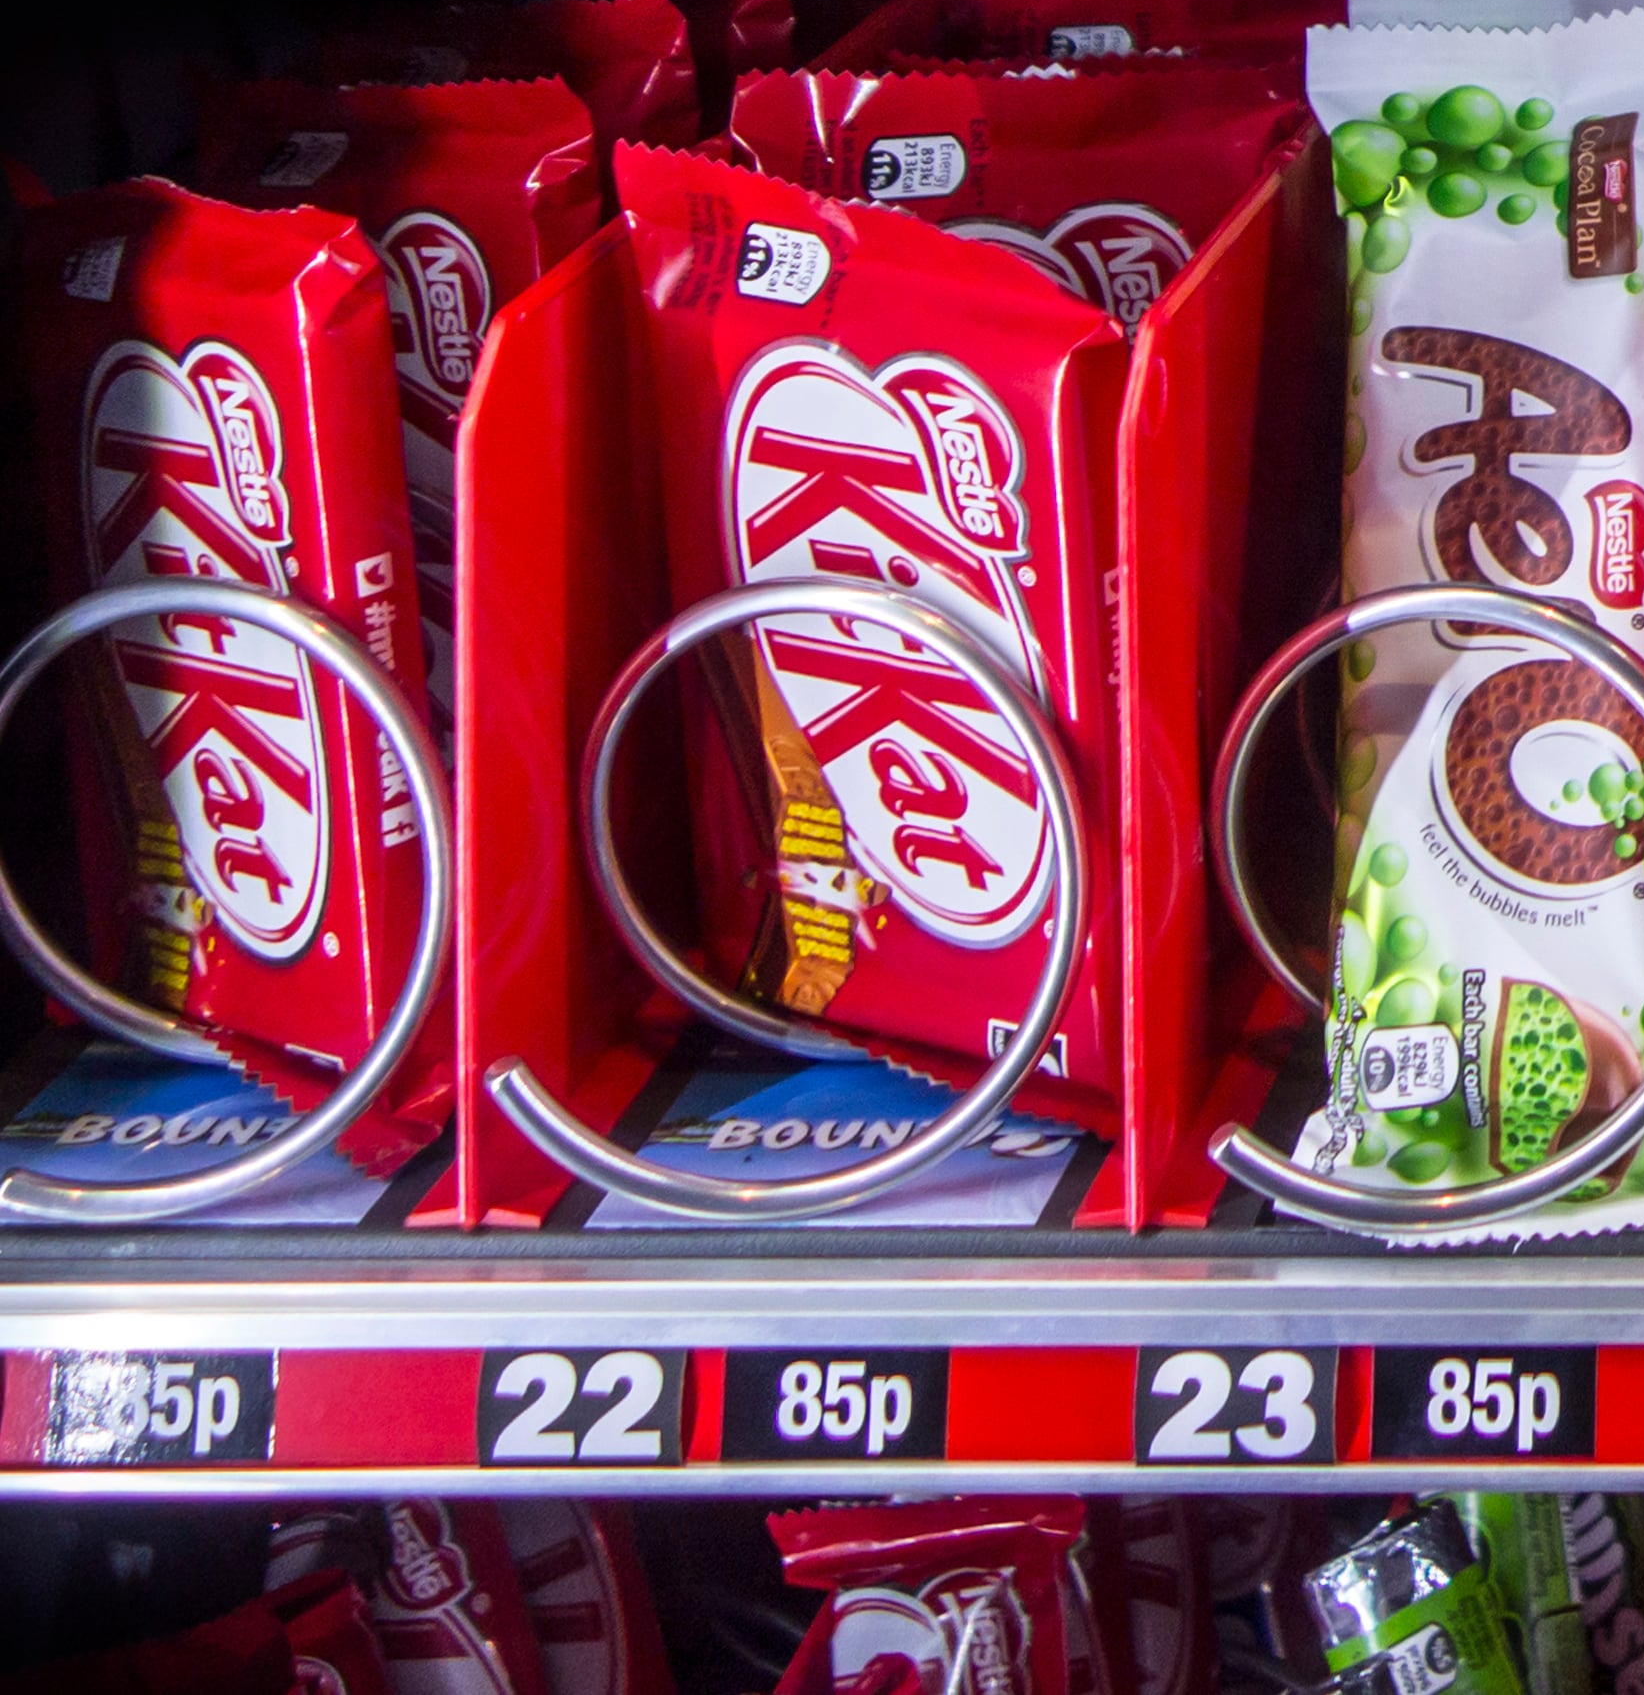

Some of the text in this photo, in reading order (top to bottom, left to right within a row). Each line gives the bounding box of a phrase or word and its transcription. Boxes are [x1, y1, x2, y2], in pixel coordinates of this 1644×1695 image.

[868, 152, 892, 189] 11%
[901, 140, 918, 194] 213kcal
[917, 146, 935, 187] 893kJ
[933, 141, 956, 189] Energy
[740, 235, 770, 280] 11%
[763, 230, 792, 295] 213kcal
[1574, 199, 1601, 267] Plan
[781, 240, 806, 289] 893kJ
[792, 239, 822, 297] Energy
[217, 376, 273, 530] Nestlé
[928, 393, 1005, 539] Nestlé
[1605, 492, 1635, 595] Nestlé
[1418, 822, 1539, 927] feel the bubbles
[1461, 968, 1485, 1019] Each
[1394, 1034, 1414, 1099] 199kcal
[1411, 1040, 1429, 1087] 829kJ
[1429, 1034, 1451, 1091] Energy
[1462, 1023, 1483, 1059] bar
[494, 1352, 663, 1457] 22
[779, 1363, 911, 1452] 85p
[1150, 1352, 1315, 1457] 23
[1428, 1361, 1559, 1450] 85p
